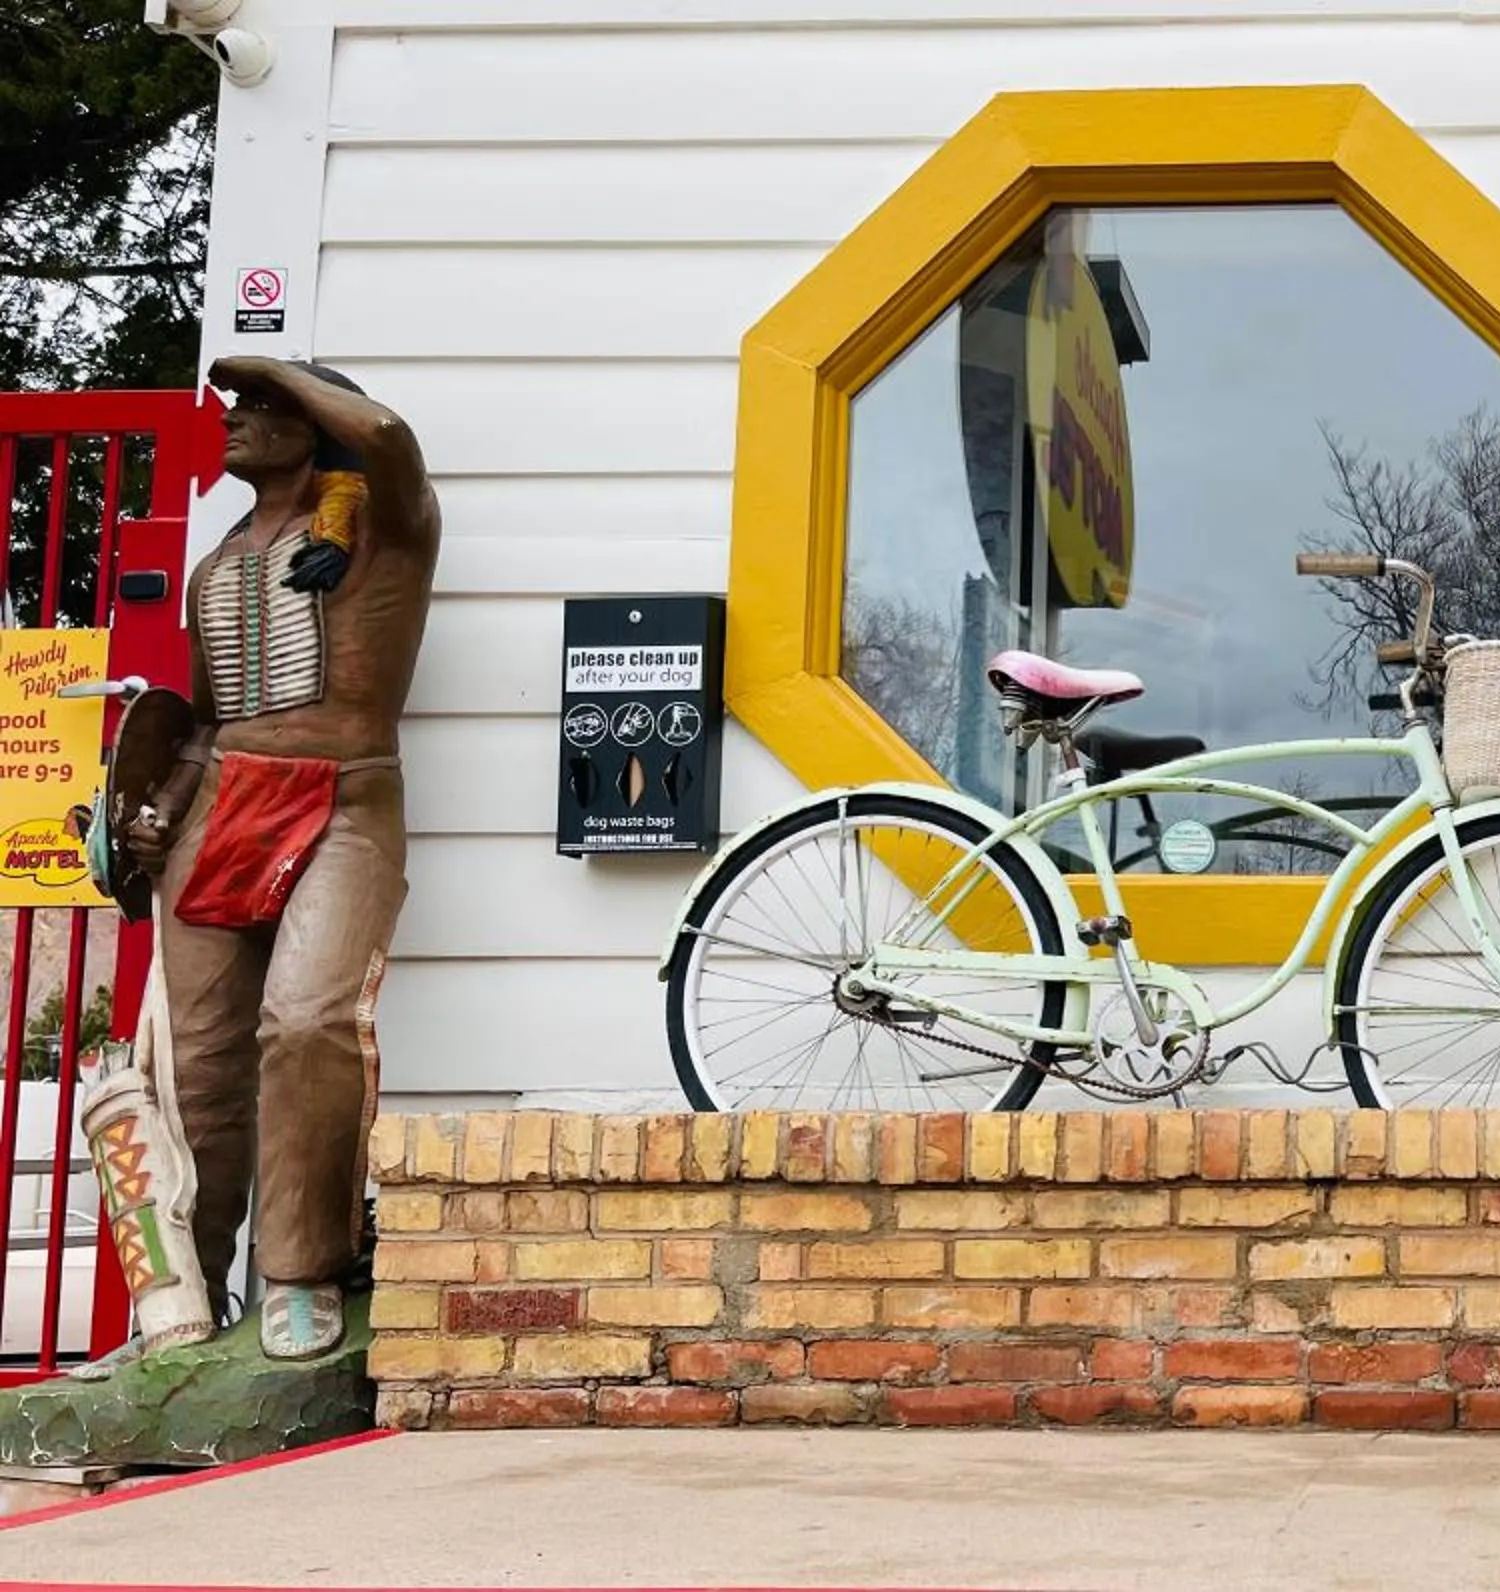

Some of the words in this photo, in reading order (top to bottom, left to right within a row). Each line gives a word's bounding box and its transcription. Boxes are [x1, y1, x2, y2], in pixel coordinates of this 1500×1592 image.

[4, 640, 67, 678] Howdy
[571, 651, 625, 668] please
[629, 650, 675, 666] clean
[679, 651, 698, 666] up
[575, 668, 614, 685] after
[618, 670, 656, 687] your
[660, 667, 693, 686] dog
[0, 708, 46, 734] pool
[35, 763, 73, 782] 9-9
[583, 815, 608, 831] dog
[609, 816, 644, 828] waste
[646, 814, 675, 829] bags
[4, 849, 85, 870] MOTEL
